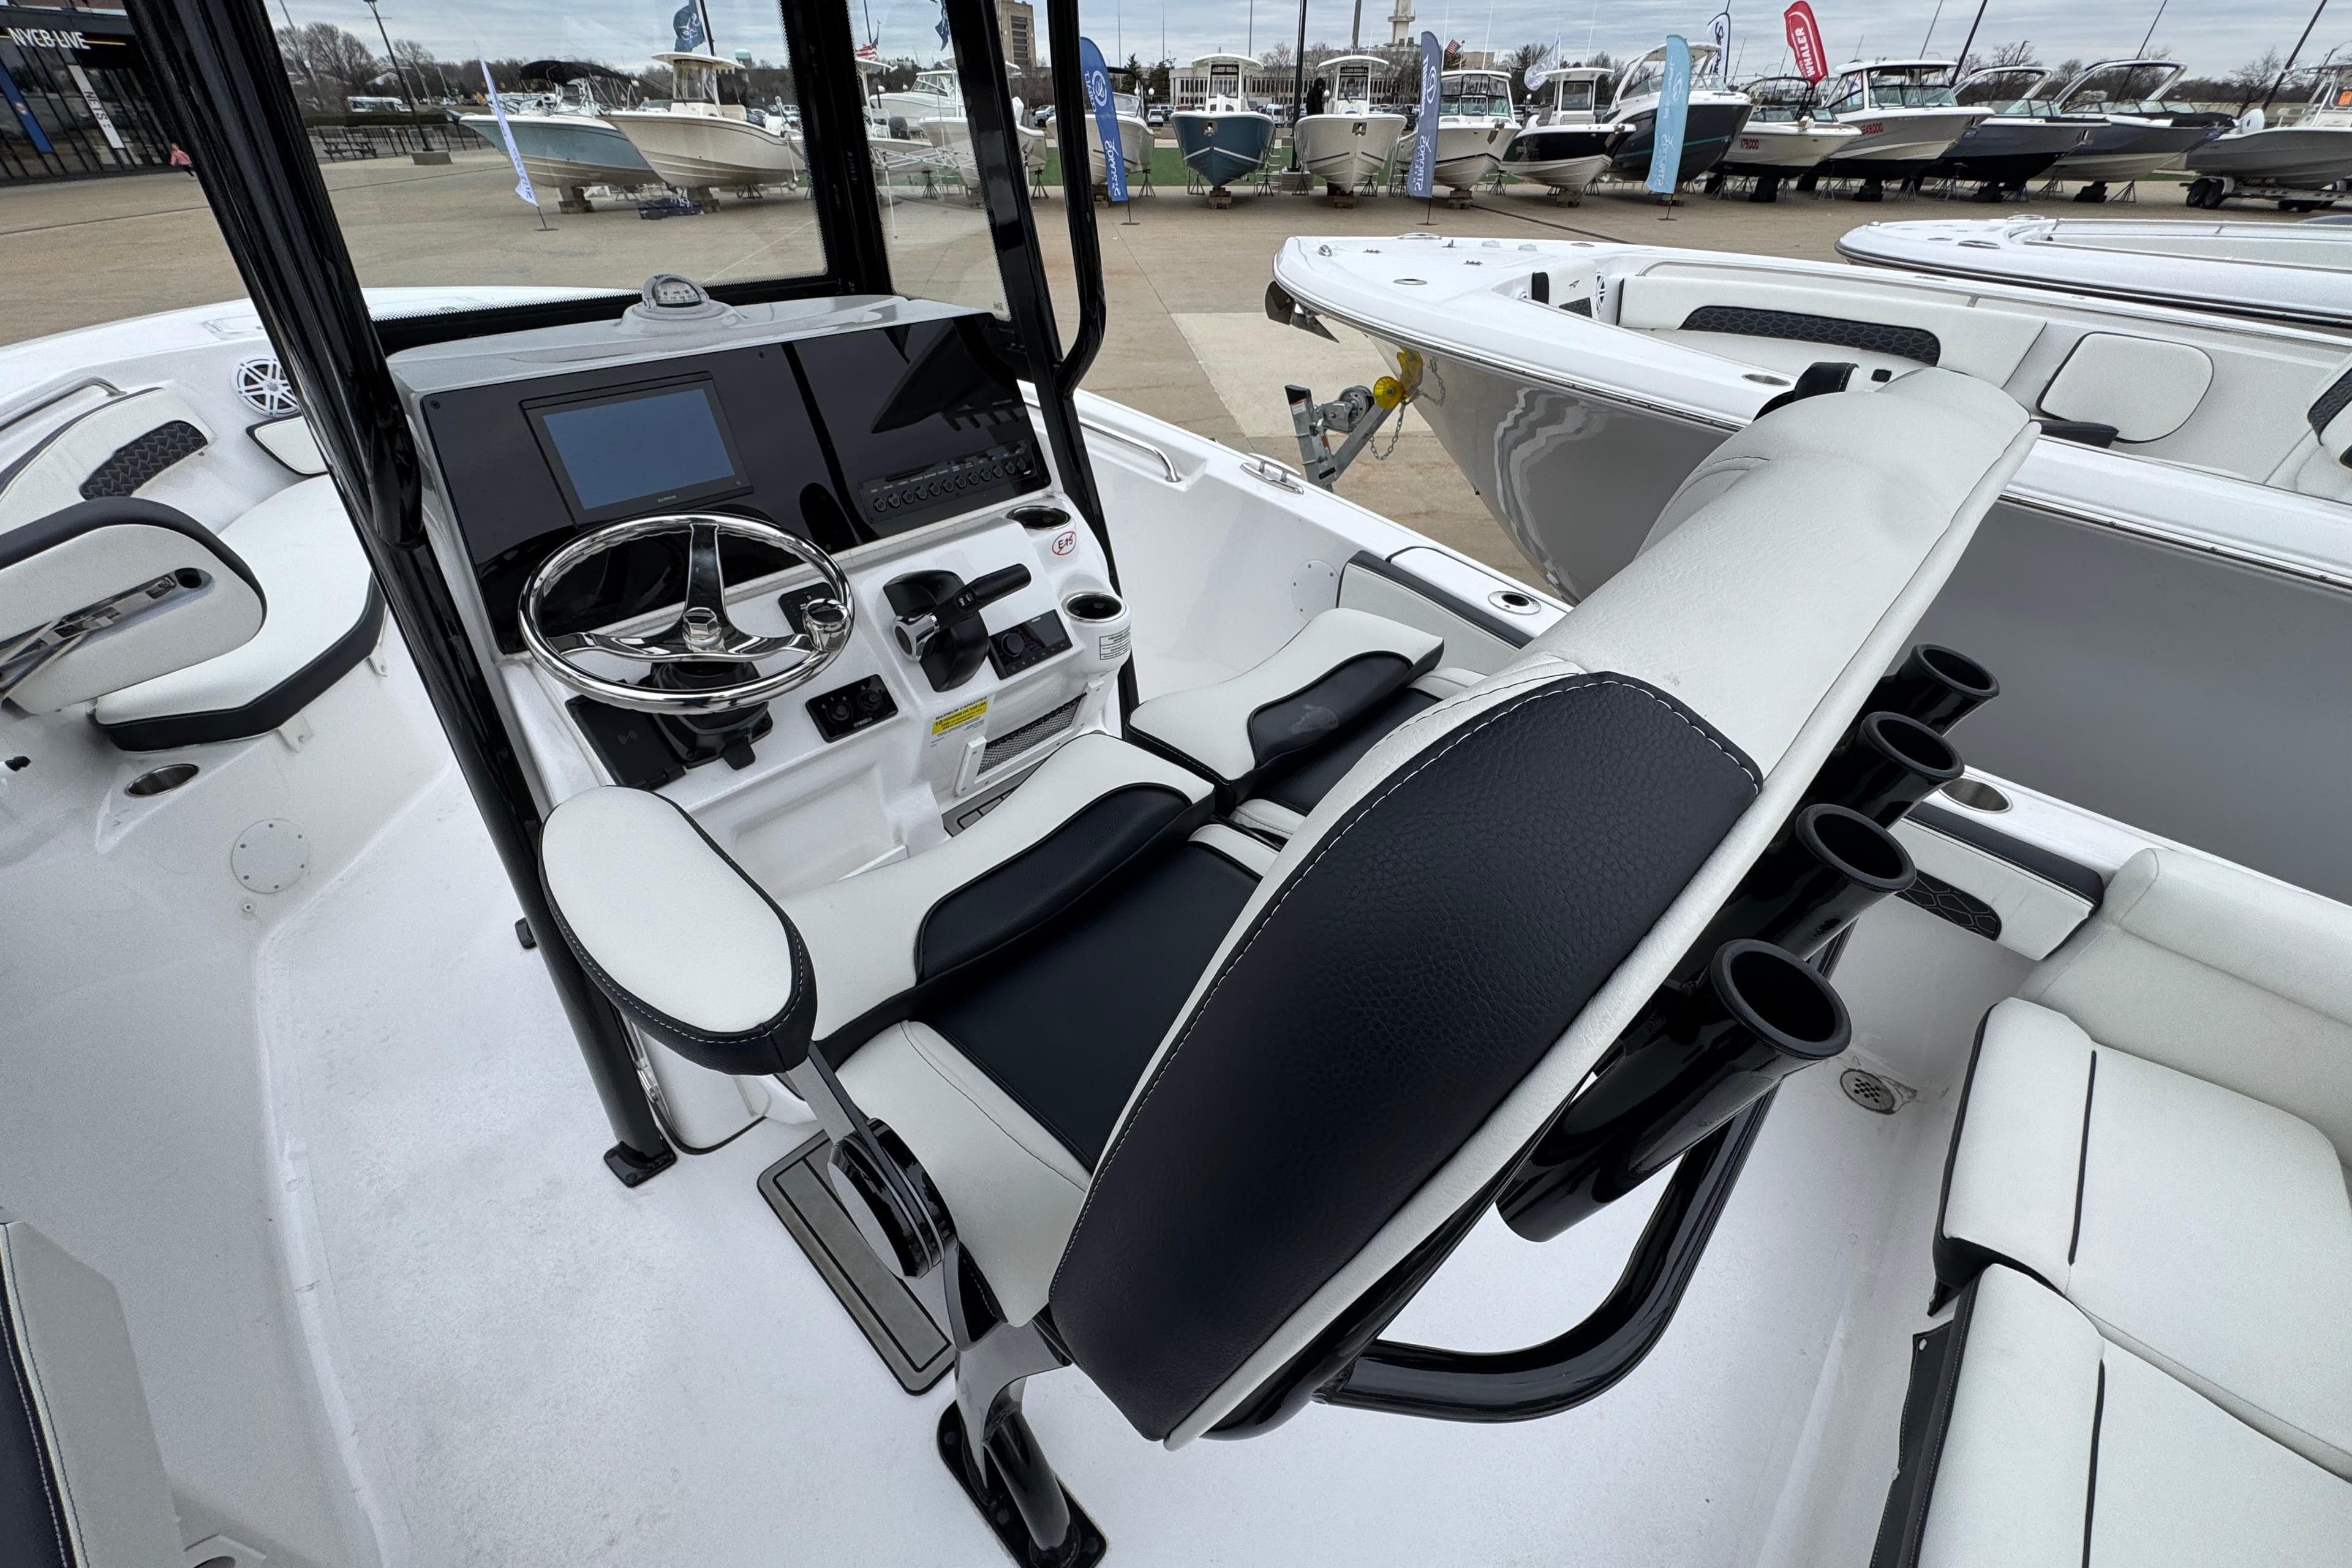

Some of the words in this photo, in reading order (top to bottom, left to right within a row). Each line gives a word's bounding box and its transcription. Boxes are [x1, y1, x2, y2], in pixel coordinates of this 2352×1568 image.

[7, 28, 55, 48] NYCB
[52, 30, 91, 50] LIVE
[1795, 27, 1816, 78] WHALER
[83, 91, 108, 121] NETS
